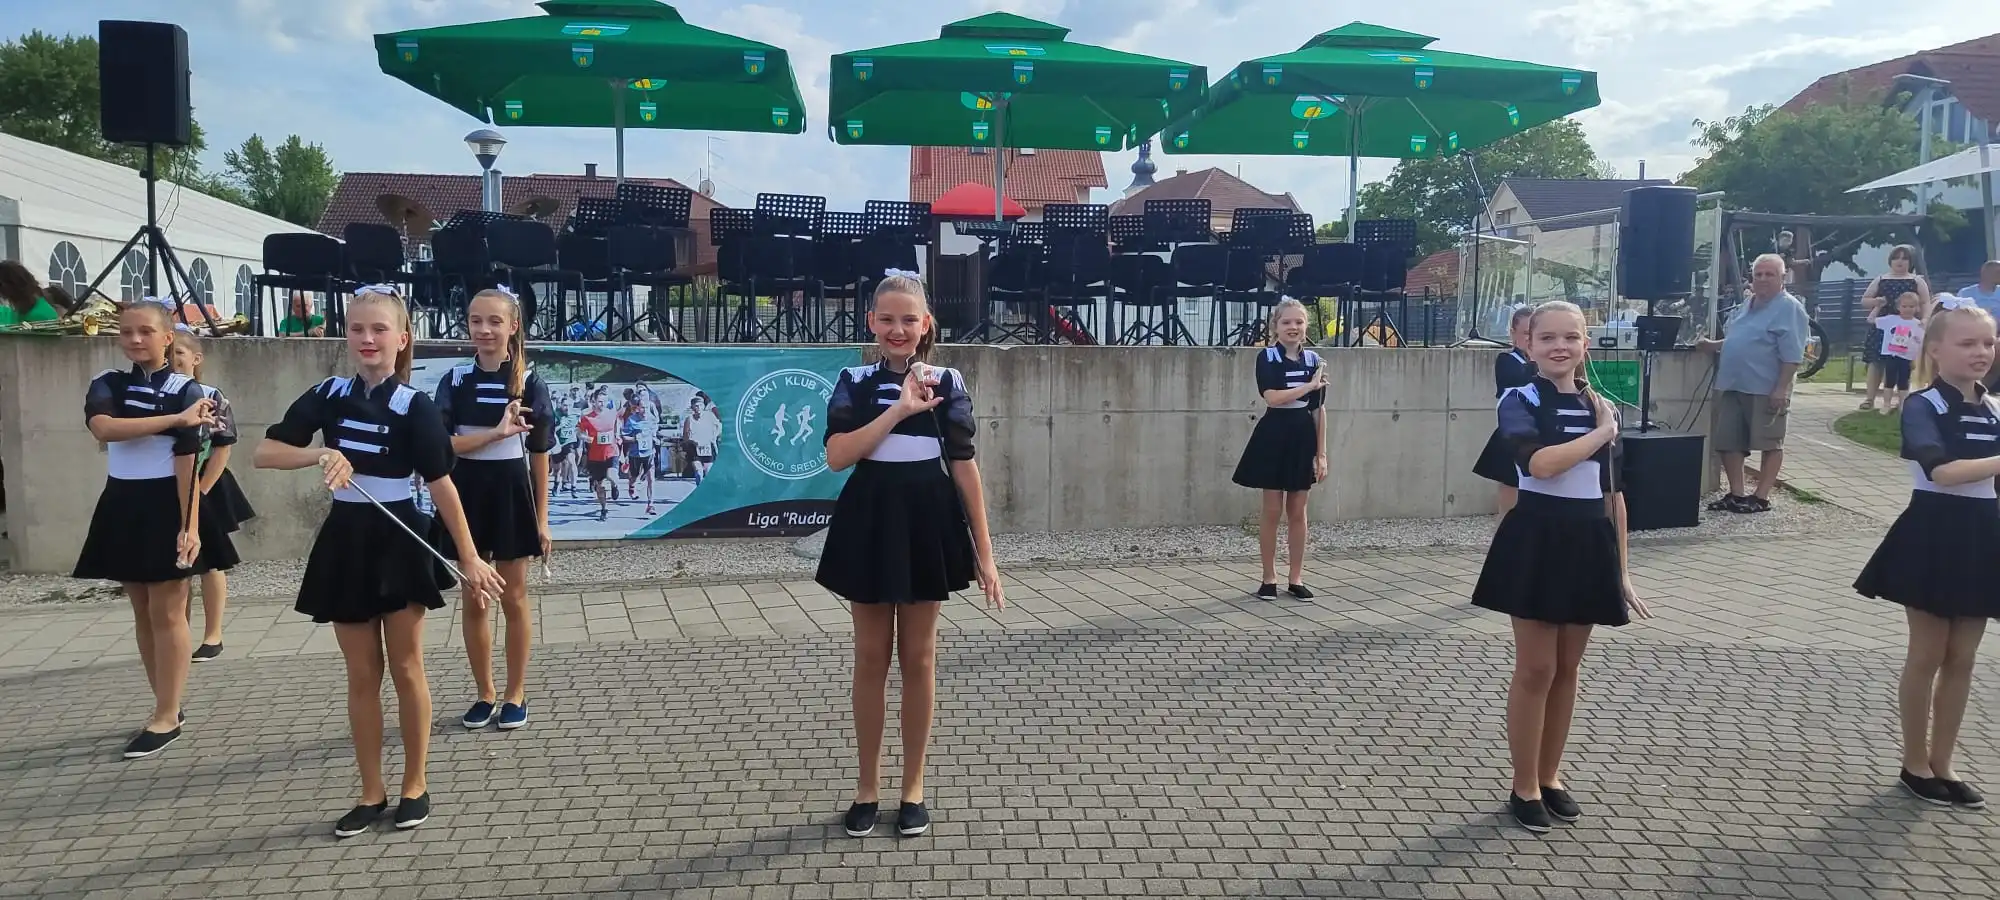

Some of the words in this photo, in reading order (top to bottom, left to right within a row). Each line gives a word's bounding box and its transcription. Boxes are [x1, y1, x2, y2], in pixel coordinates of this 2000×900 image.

[784, 375, 816, 390] KLUB
[749, 442, 785, 471] MURSKO
[748, 512, 779, 529] Liga
[783, 511, 832, 525] "Rudar
